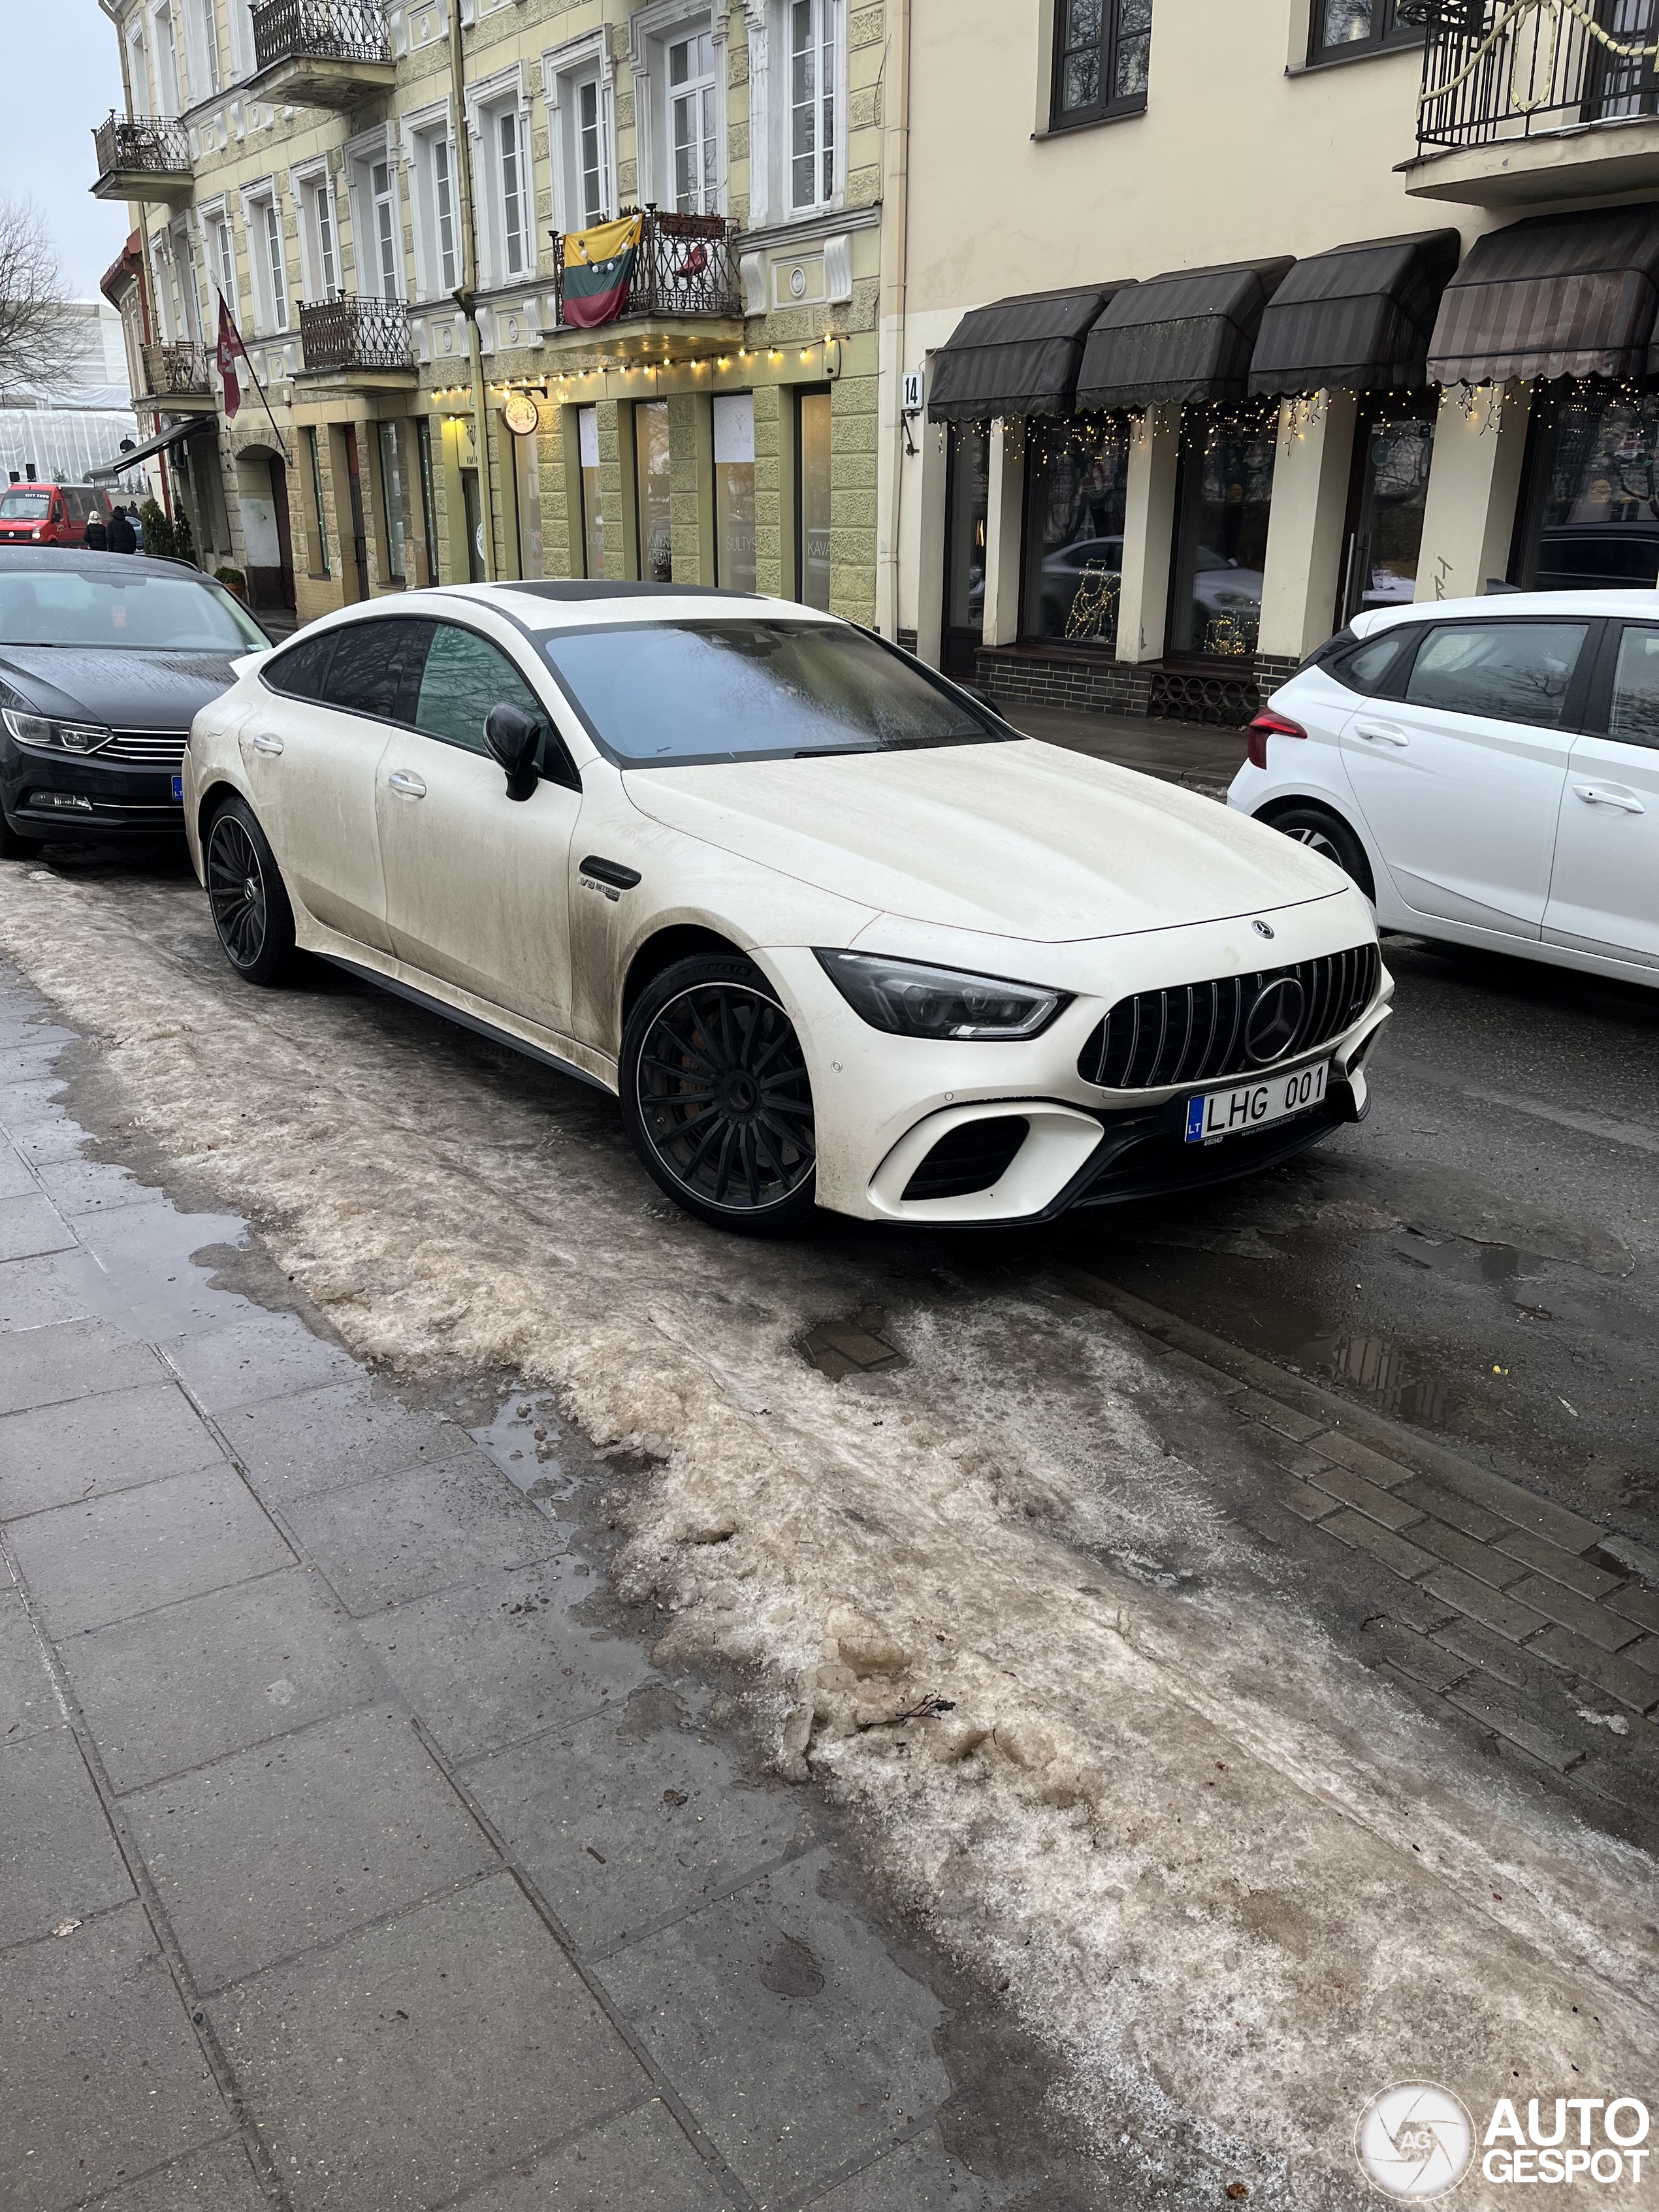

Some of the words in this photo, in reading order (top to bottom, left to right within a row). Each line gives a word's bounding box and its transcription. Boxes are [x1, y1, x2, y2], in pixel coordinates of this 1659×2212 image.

[905, 377, 918, 404] 14
[807, 540, 831, 556] KAVA
[580, 876, 595, 890] V8
[685, 963, 748, 975] MICHELIN
[1188, 1123, 1201, 1134] LT
[1206, 1086, 1268, 1132] LHG
[1285, 1065, 1324, 1109] 001
